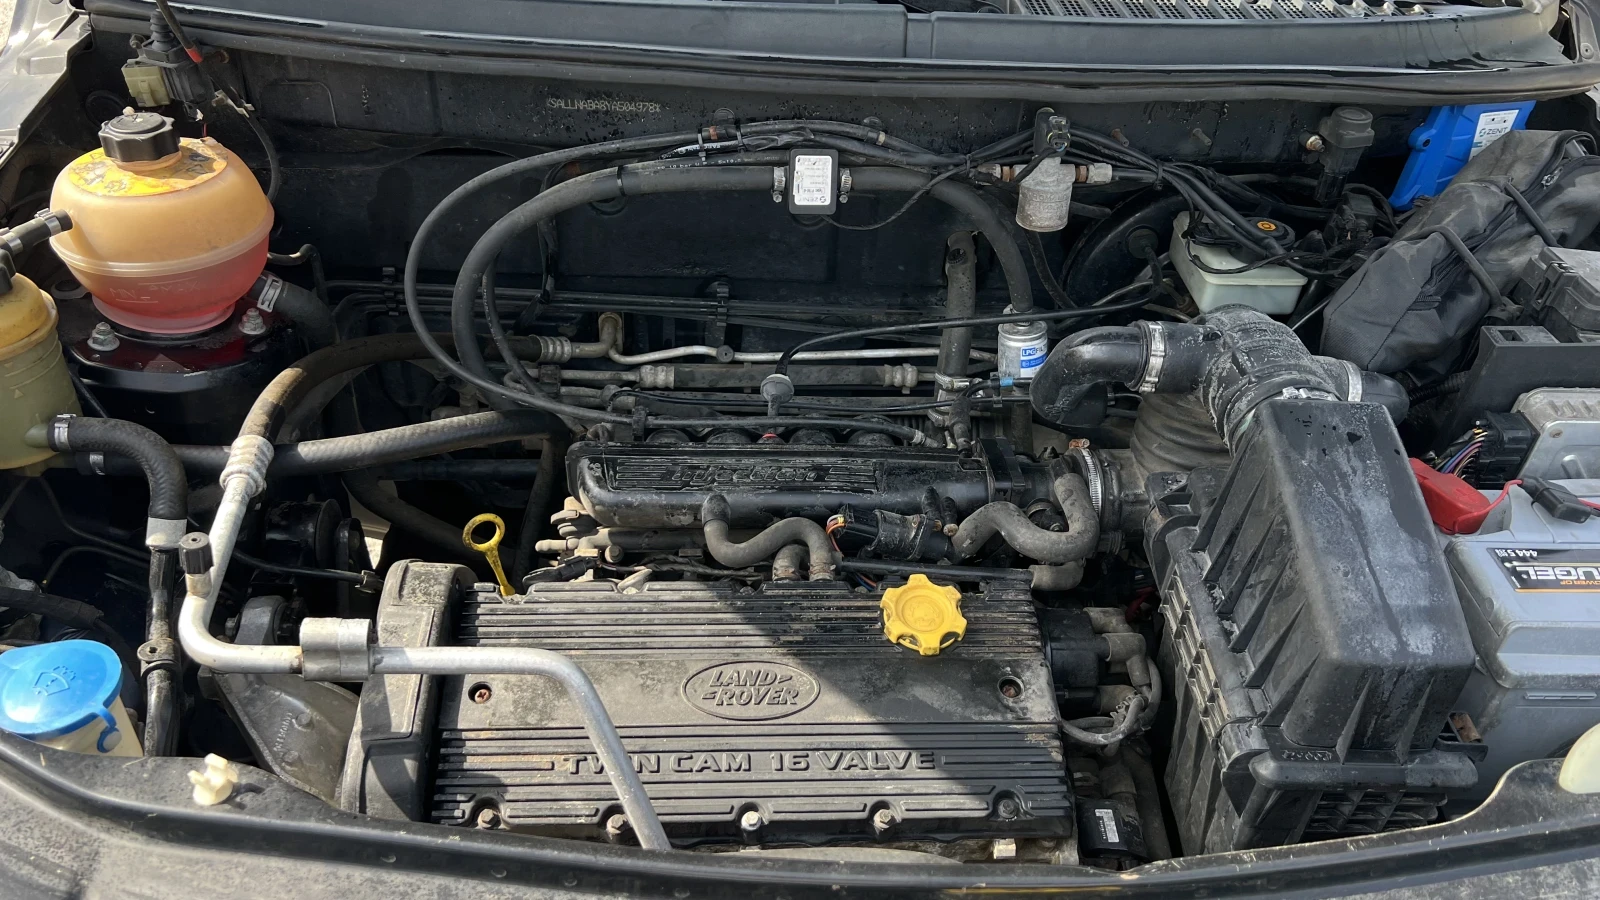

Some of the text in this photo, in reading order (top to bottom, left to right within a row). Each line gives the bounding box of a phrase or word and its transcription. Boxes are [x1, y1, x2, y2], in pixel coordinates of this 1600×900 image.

[1487, 127, 1508, 135] ZENIT
[1022, 348, 1036, 357] LPG
[1516, 566, 1600, 580] UGEL
[709, 668, 778, 688] LAND
[715, 687, 799, 706] ROVER
[671, 753, 751, 773] CAM
[770, 752, 810, 771] 16
[815, 750, 936, 771] VALVE
